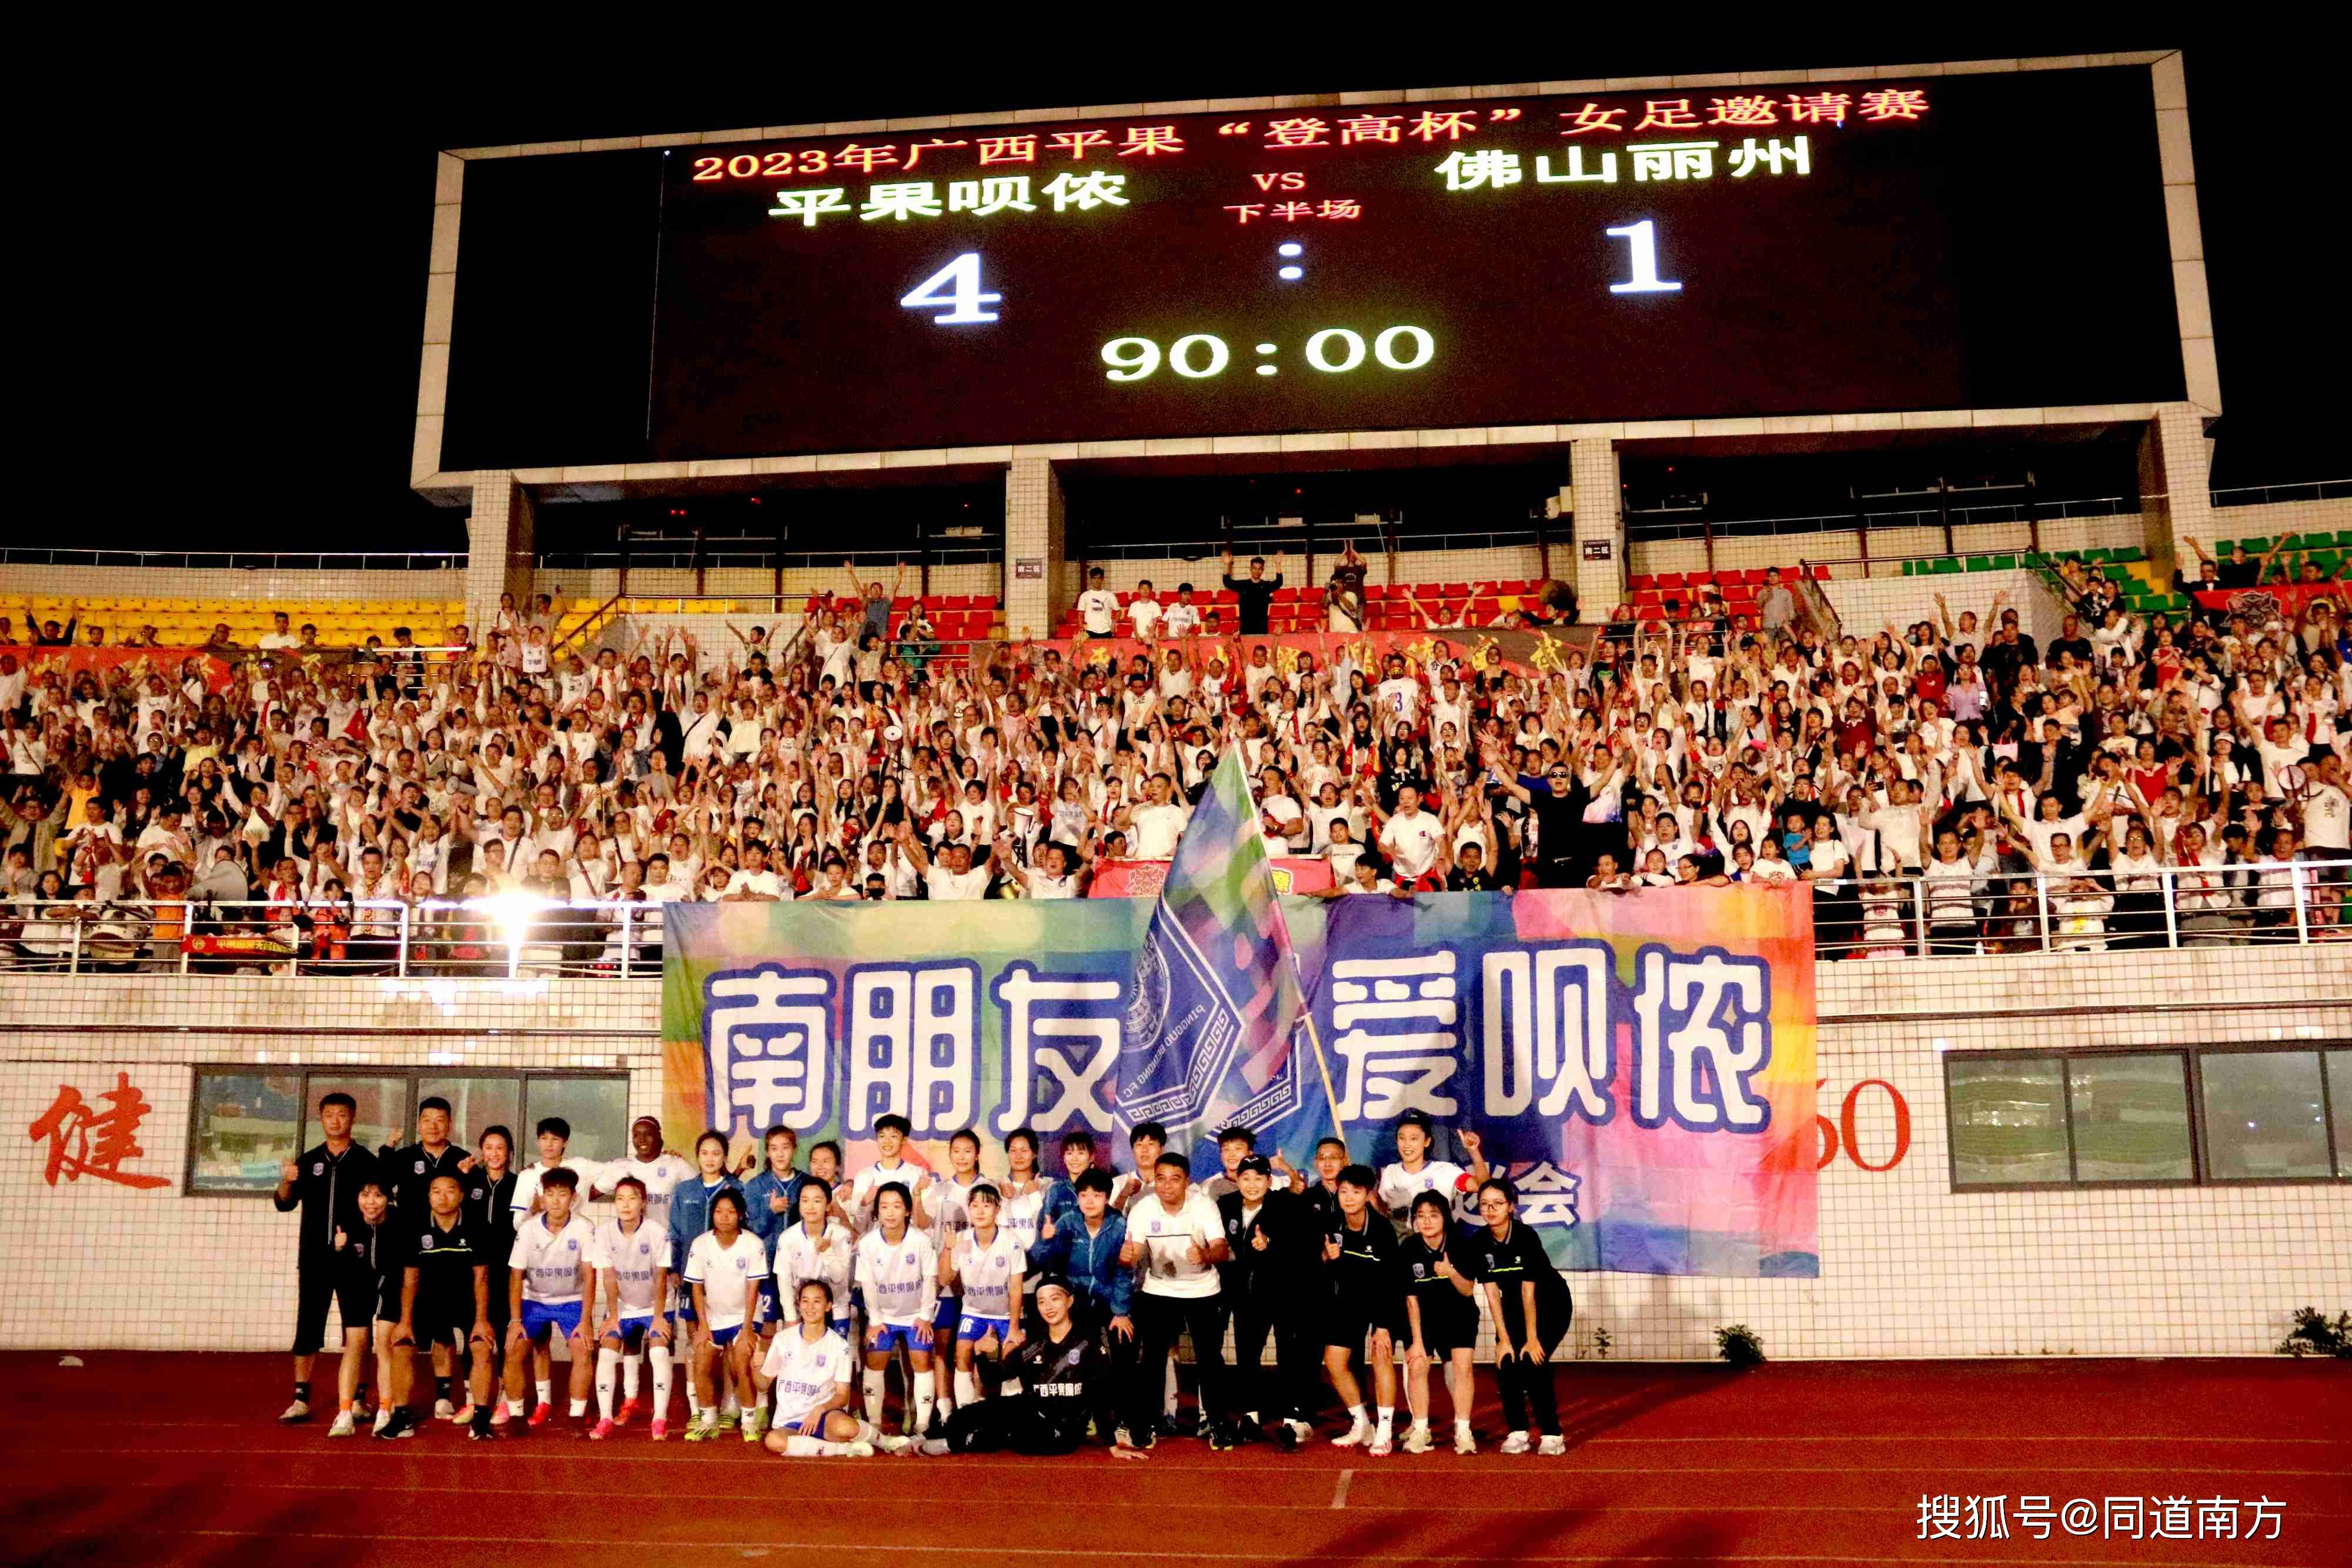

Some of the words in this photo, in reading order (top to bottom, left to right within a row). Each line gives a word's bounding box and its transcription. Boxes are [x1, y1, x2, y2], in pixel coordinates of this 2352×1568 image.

[693, 125, 1184, 181] 2023年广西平果
[1560, 88, 1929, 135] 女足邀请赛
[1252, 172, 1306, 190] VS
[1434, 135, 1810, 190] 佛山丽州
[767, 171, 1130, 226] 平果呗侬
[1223, 200, 1361, 223] 下半场
[900, 253, 1001, 324] 4
[1606, 220, 1682, 293] 1
[1101, 326, 1435, 381] 90:00
[29, 1072, 171, 1189] 健
